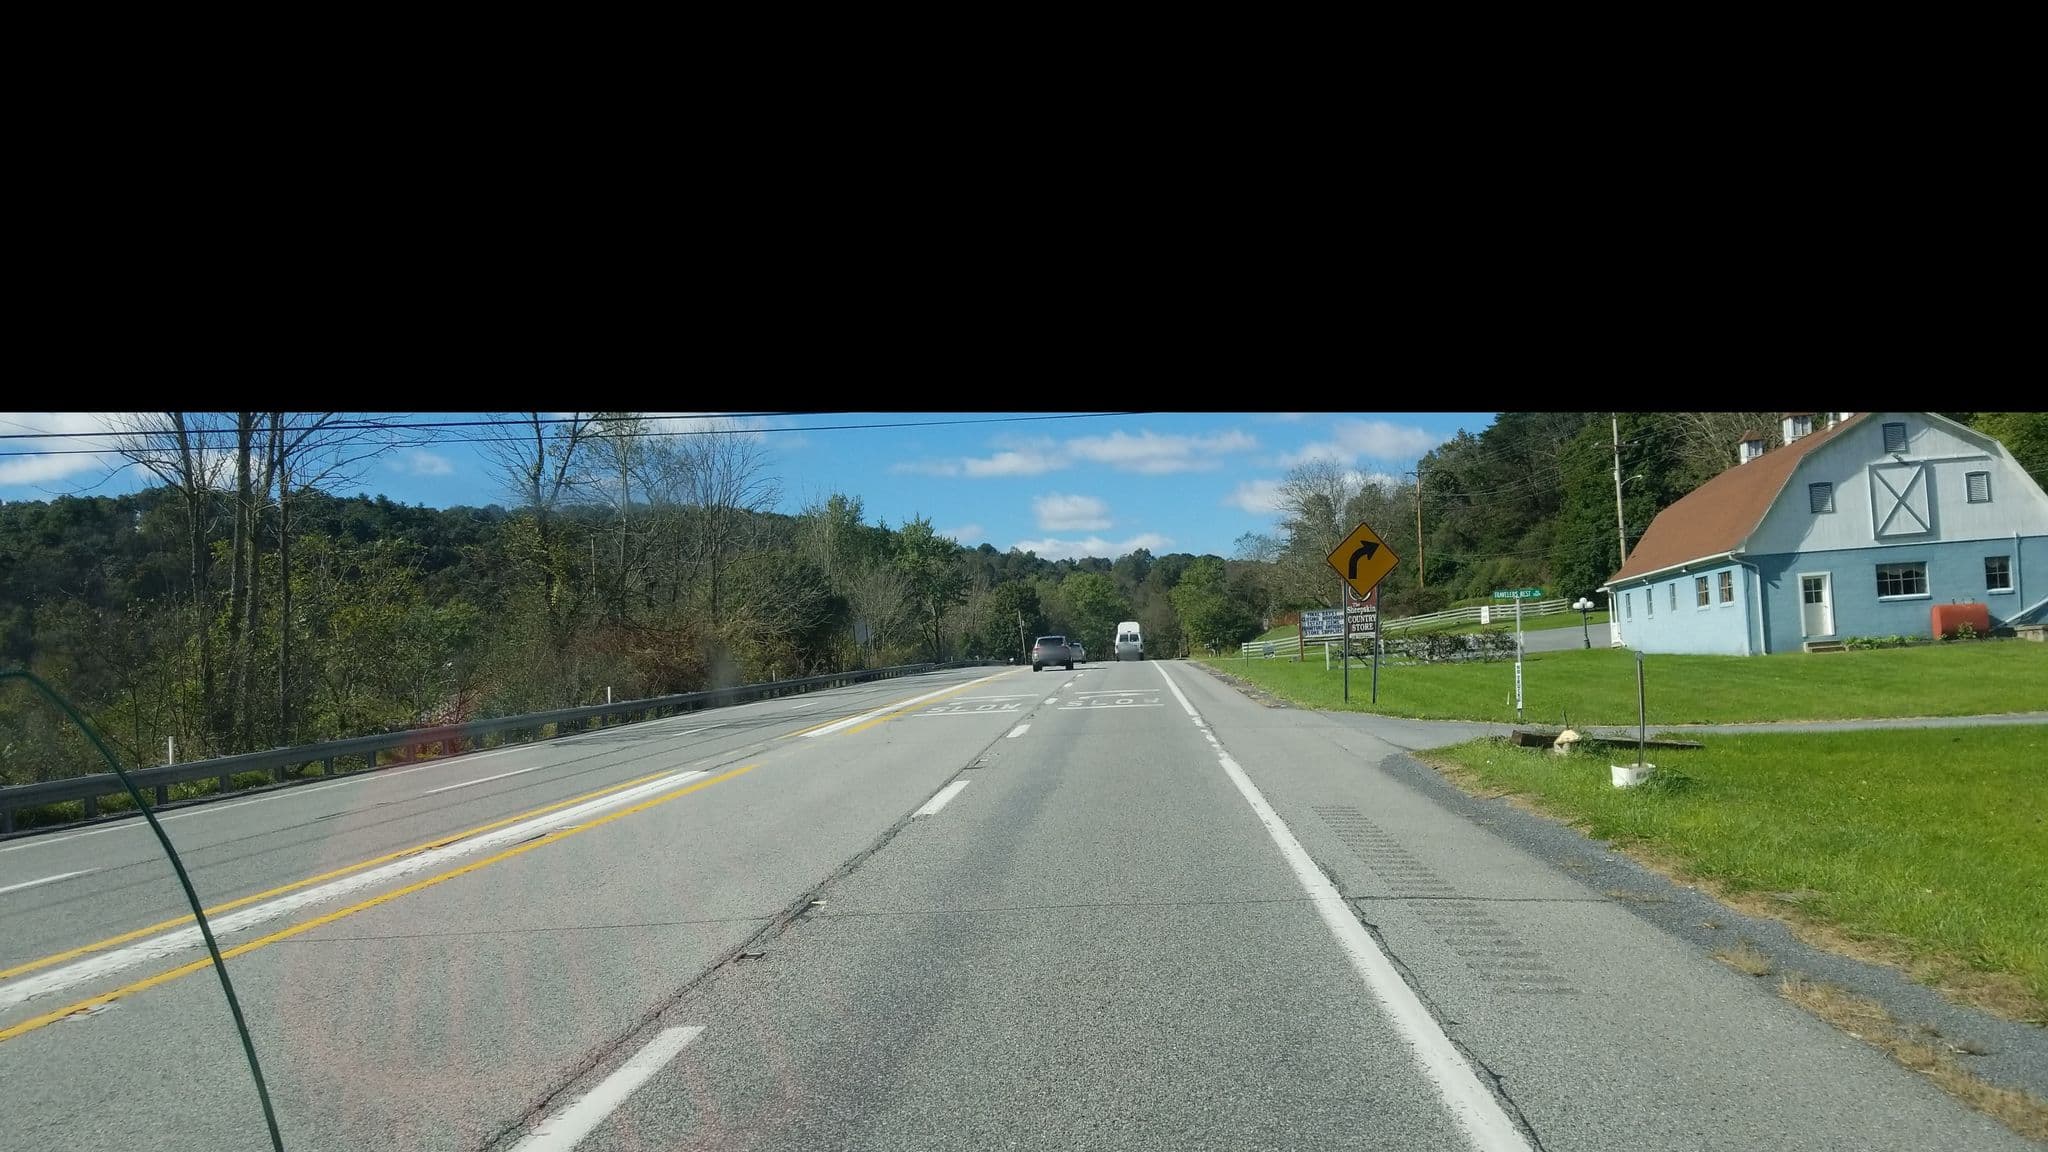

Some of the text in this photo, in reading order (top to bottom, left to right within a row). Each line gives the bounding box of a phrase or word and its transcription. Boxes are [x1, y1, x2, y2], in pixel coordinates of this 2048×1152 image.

[1347, 604, 1376, 614] Sheepskin
[1347, 615, 1376, 623] COUNTRY
[1352, 623, 1374, 632] STORE
[926, 703, 1021, 713] SLOW
